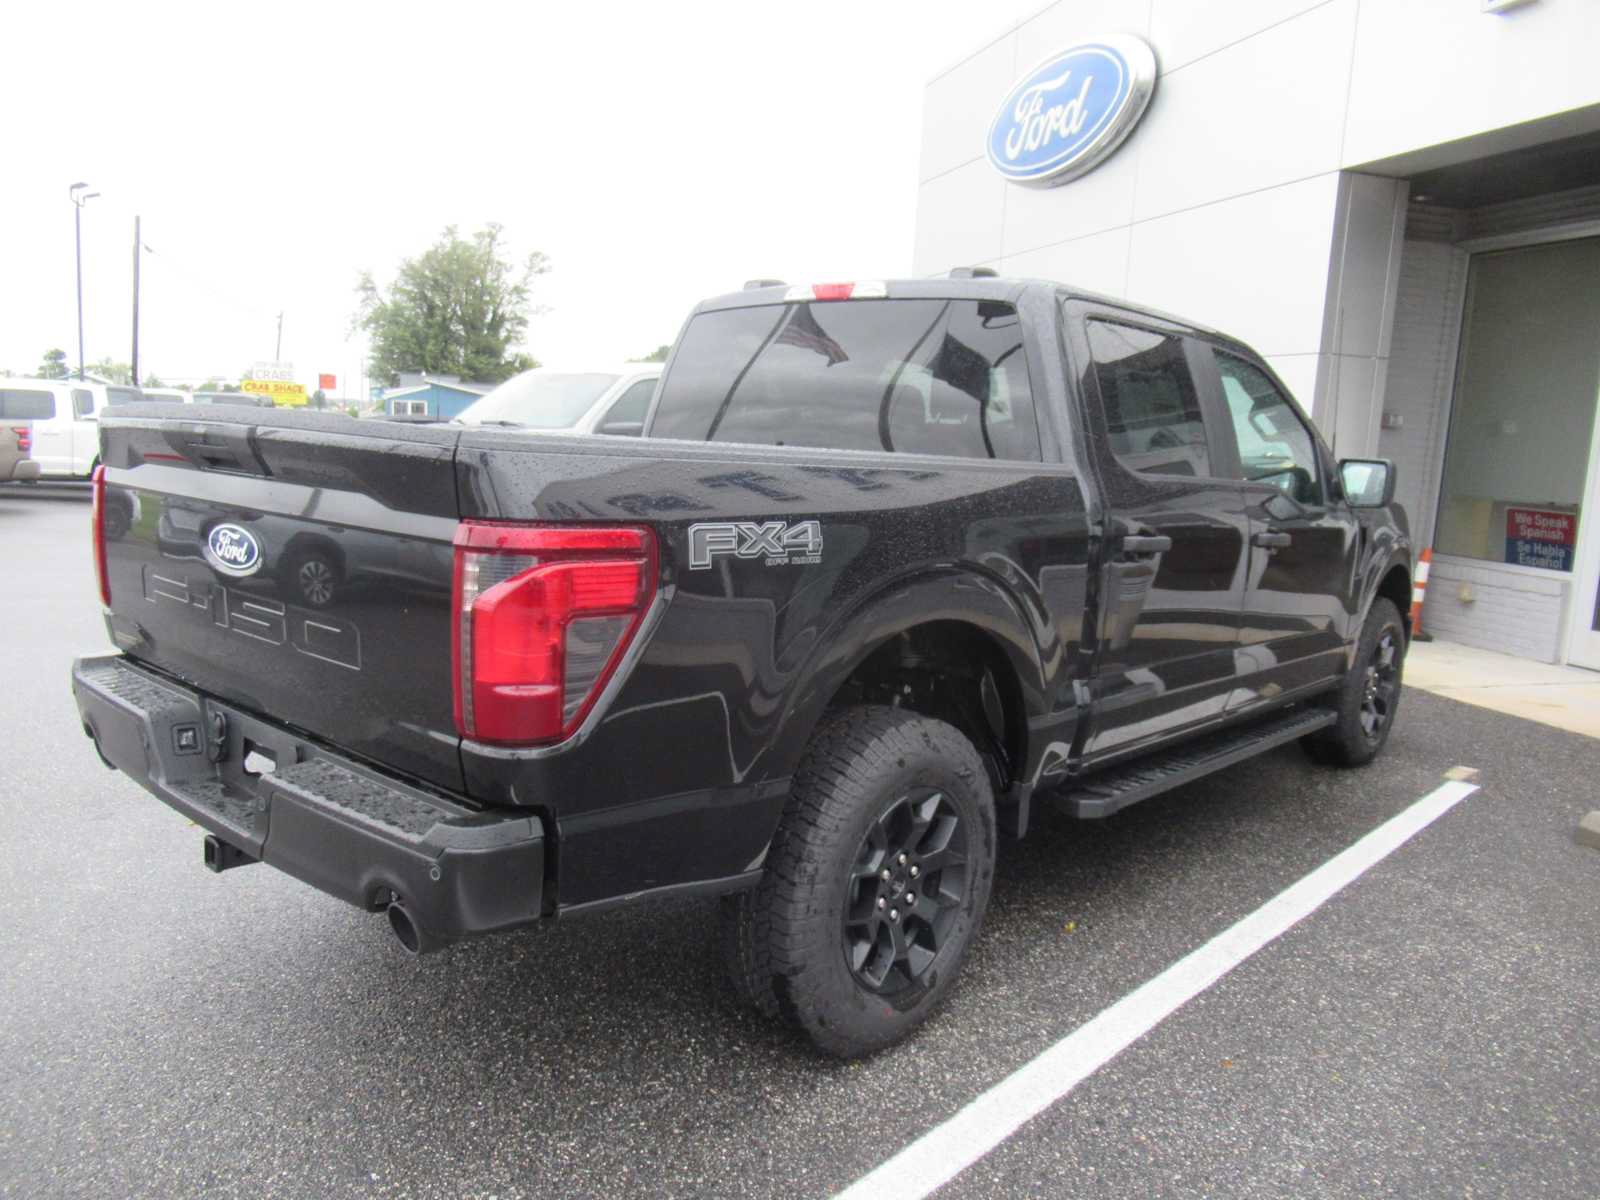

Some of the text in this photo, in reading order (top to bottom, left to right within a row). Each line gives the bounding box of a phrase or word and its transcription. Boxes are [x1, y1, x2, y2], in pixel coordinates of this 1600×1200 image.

[1005, 70, 1093, 160] Ford
[1514, 511, 1568, 529] We Speak
[1519, 525, 1564, 541] Spanish
[216, 529, 248, 563] Ford
[688, 521, 823, 570] FX4
